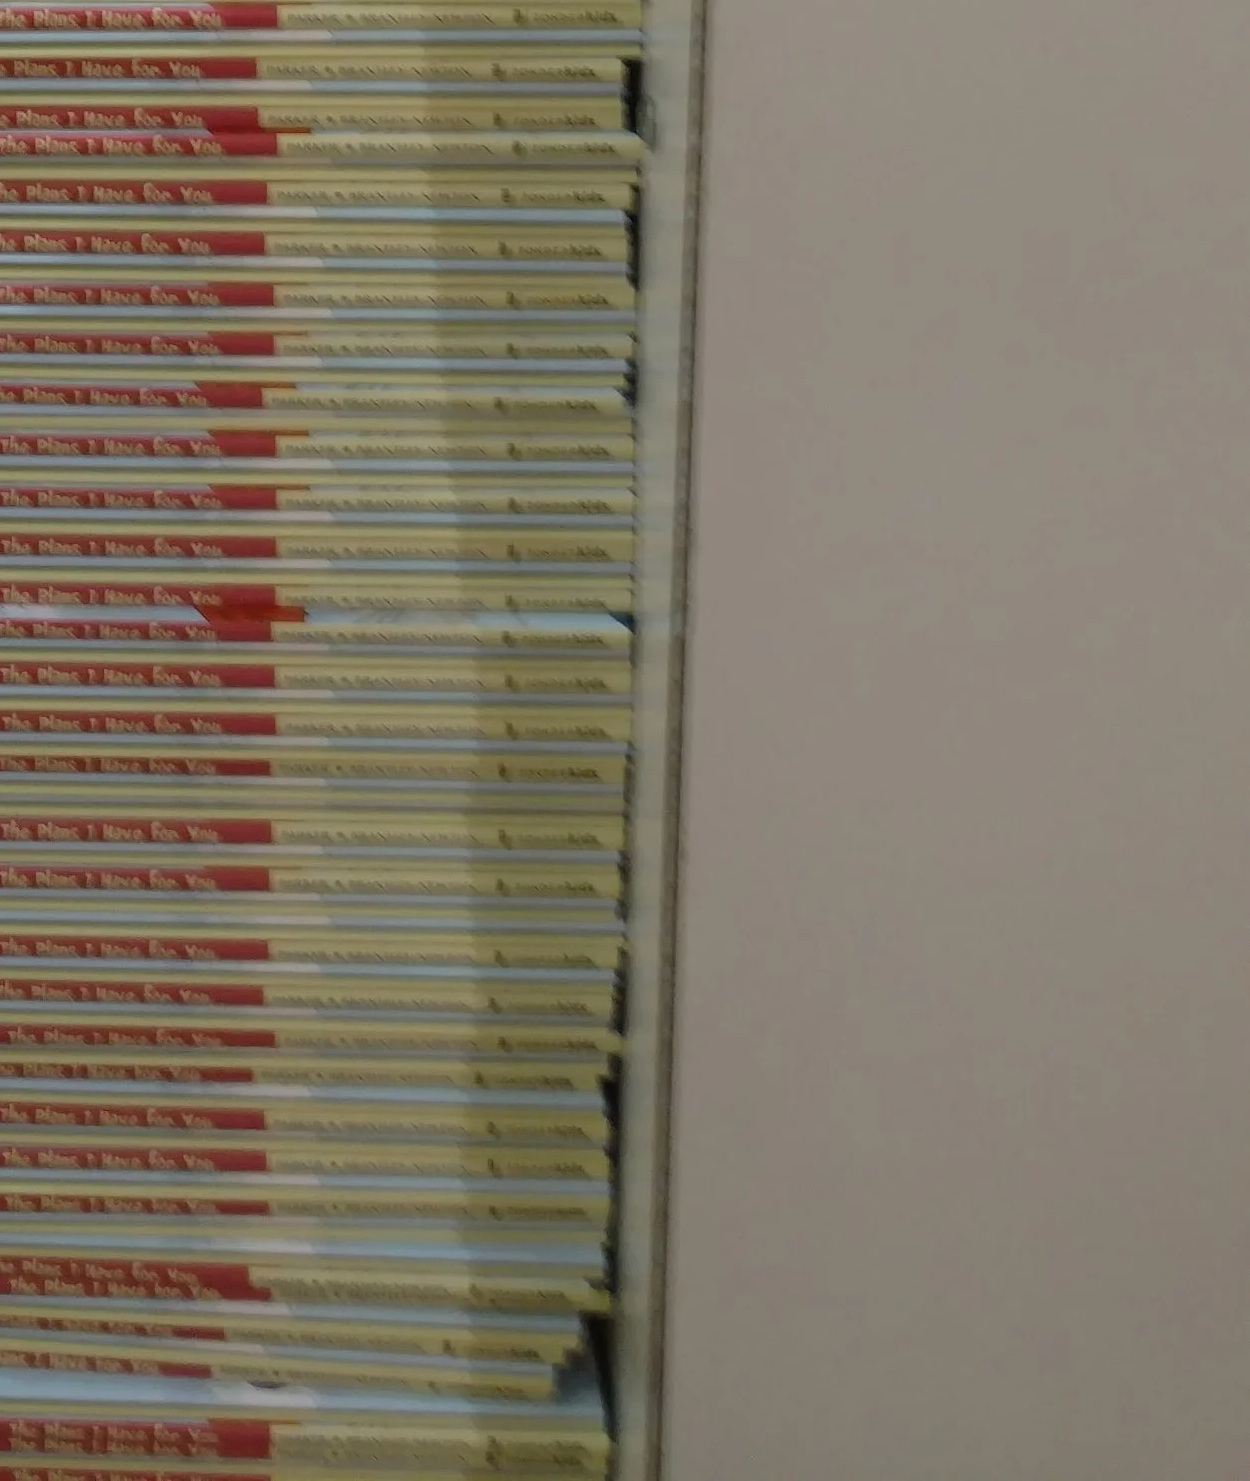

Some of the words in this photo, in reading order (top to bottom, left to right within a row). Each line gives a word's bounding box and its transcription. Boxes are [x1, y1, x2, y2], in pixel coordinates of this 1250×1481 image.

[32, 8, 78, 28] Plans
[85, 9, 95, 29] I
[100, 9, 145, 29] Have
[150, 7, 182, 29] for
[190, 10, 223, 29] You
[22, 234, 68, 255] Plans
[74, 234, 84, 255] I
[89, 235, 135, 256] Have
[139, 233, 170, 256] for
[177, 237, 211, 257] You
[0, 489, 31, 508] The
[36, 490, 81, 509] Plans
[87, 490, 98, 509] I
[102, 491, 147, 510] Have
[152, 489, 183, 510] for
[189, 492, 222, 510] You
